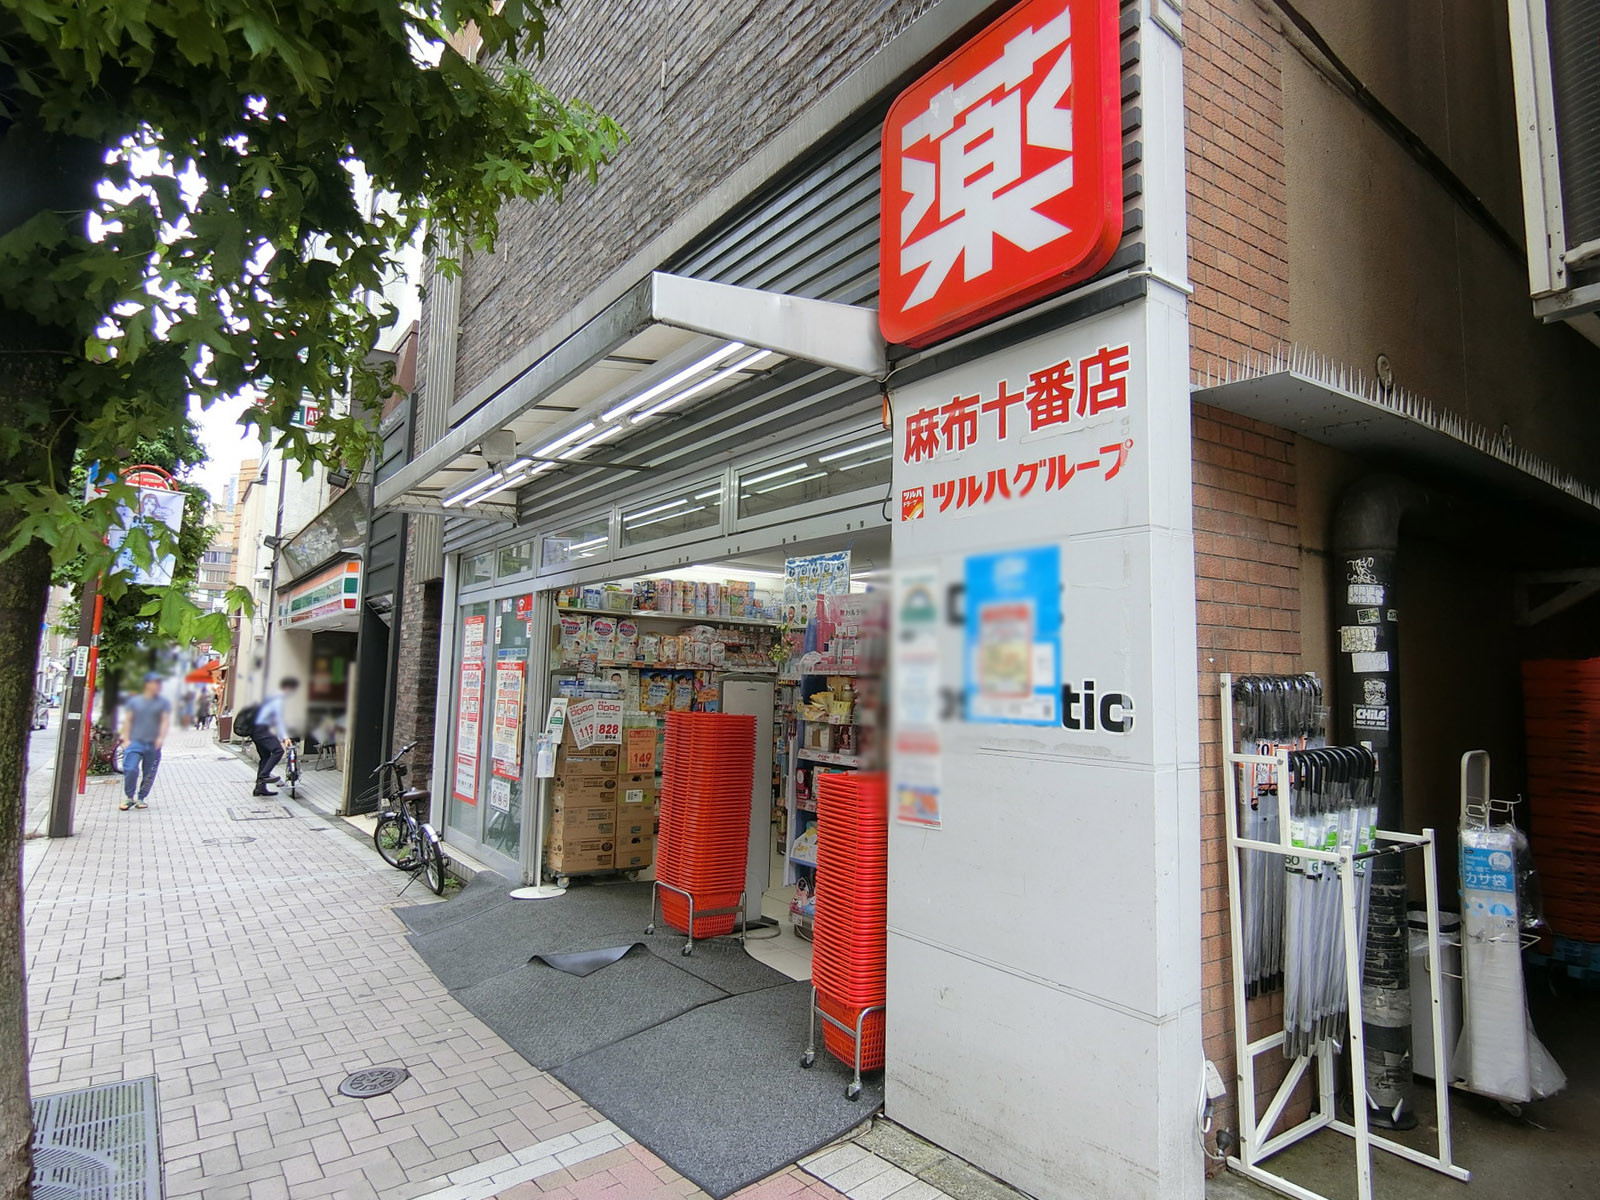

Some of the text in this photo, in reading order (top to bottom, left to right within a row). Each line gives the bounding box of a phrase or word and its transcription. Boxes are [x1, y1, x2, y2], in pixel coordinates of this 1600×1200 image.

[900, 6, 1073, 313] 薬
[903, 345, 1130, 464] 麻布十番店
[932, 438, 1134, 513] ツルハグループ
[599, 723, 619, 735] 828
[633, 752, 652, 764] 149
[1465, 872, 1508, 888] カサ袋
